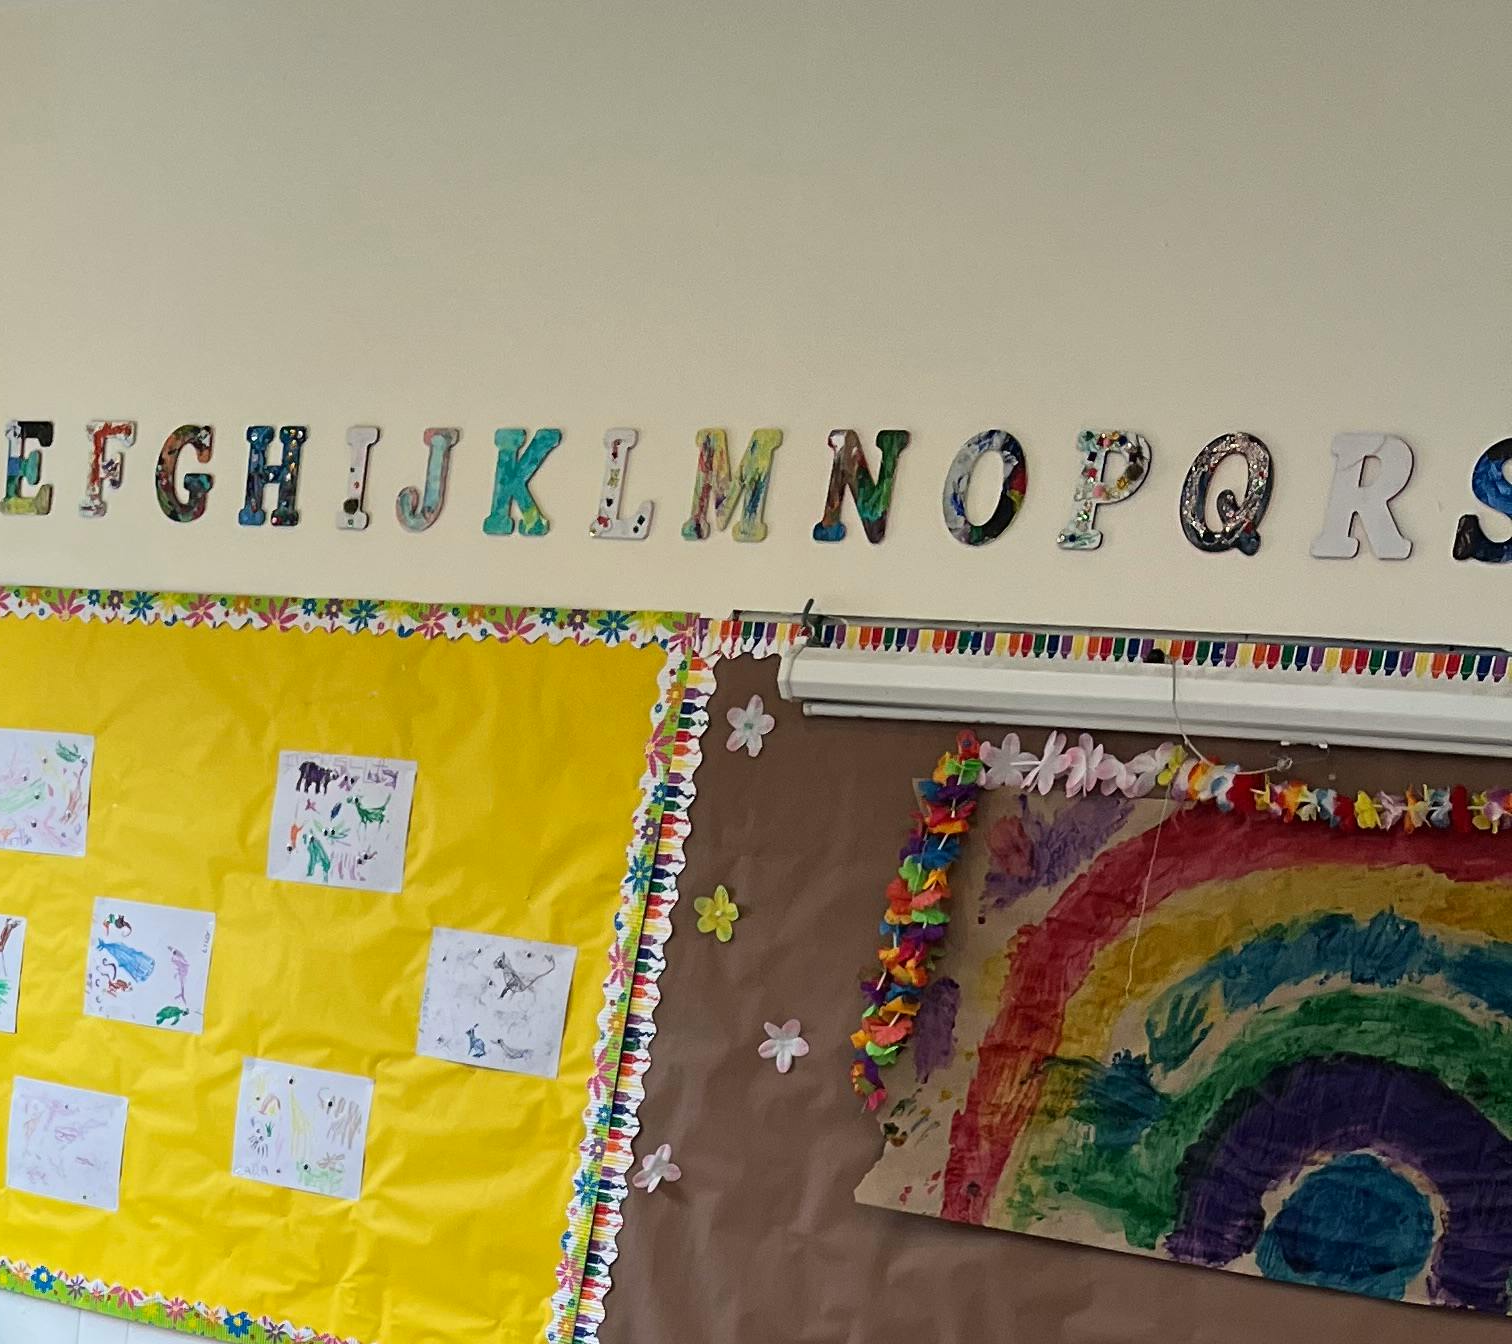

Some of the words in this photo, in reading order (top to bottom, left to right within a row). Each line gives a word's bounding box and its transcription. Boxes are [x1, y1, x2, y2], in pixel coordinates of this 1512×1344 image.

[0, 420, 55, 516] E
[79, 420, 138, 518] F
[155, 424, 215, 524] G
[239, 426, 310, 528] H
[337, 425, 382, 531] I
[396, 427, 462, 533] J
[483, 428, 564, 538] K
[590, 428, 657, 542] L
[683, 428, 784, 543] M
[812, 429, 913, 546] N
[944, 429, 1031, 547] O
[1057, 430, 1155, 551] P
[1178, 432, 1276, 557] Q
[1310, 433, 1418, 562] R
[1451, 437, 1511, 565] S
